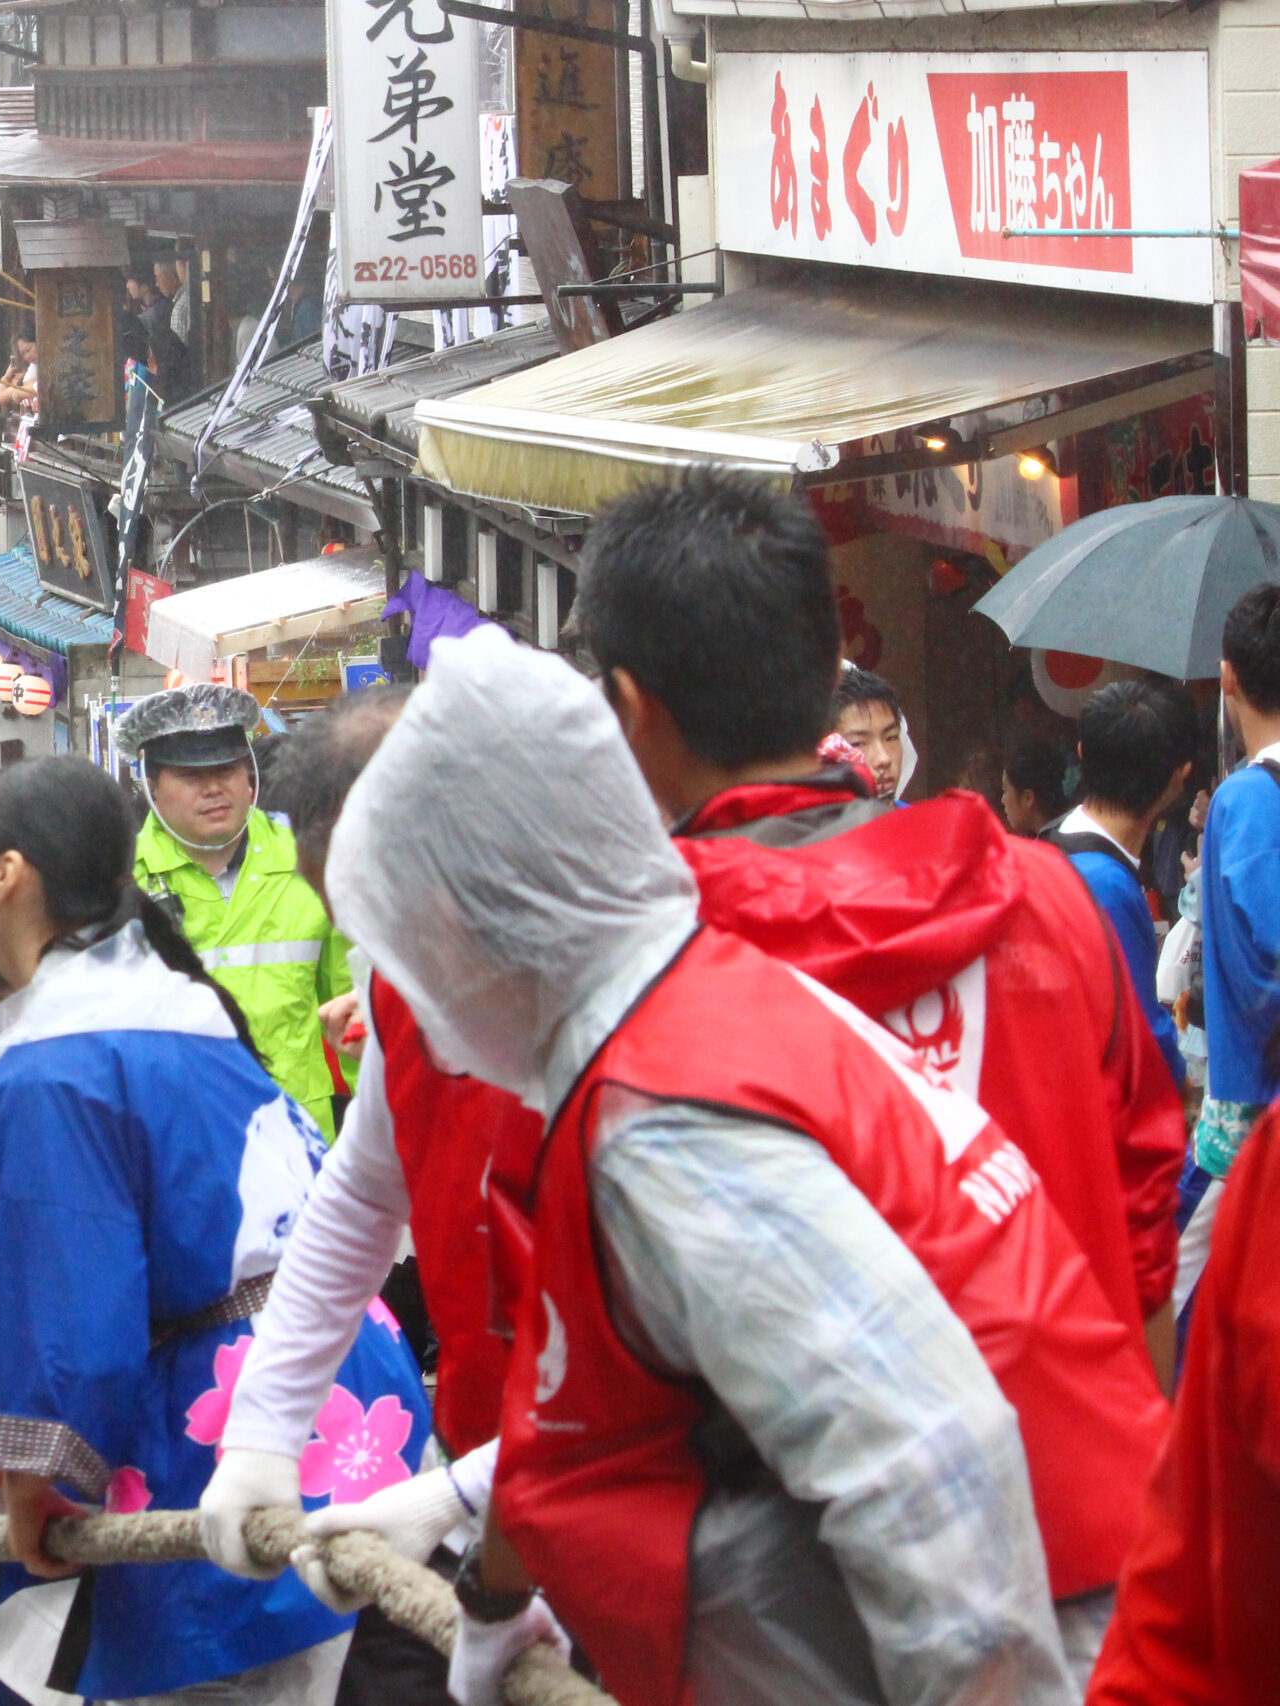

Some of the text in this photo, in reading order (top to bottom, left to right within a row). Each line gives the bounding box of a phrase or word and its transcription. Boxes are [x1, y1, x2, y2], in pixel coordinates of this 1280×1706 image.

[770, 70, 1114, 247] あまぐり 加藤ちゃん
[378, 253, 478, 282] 22-0568
